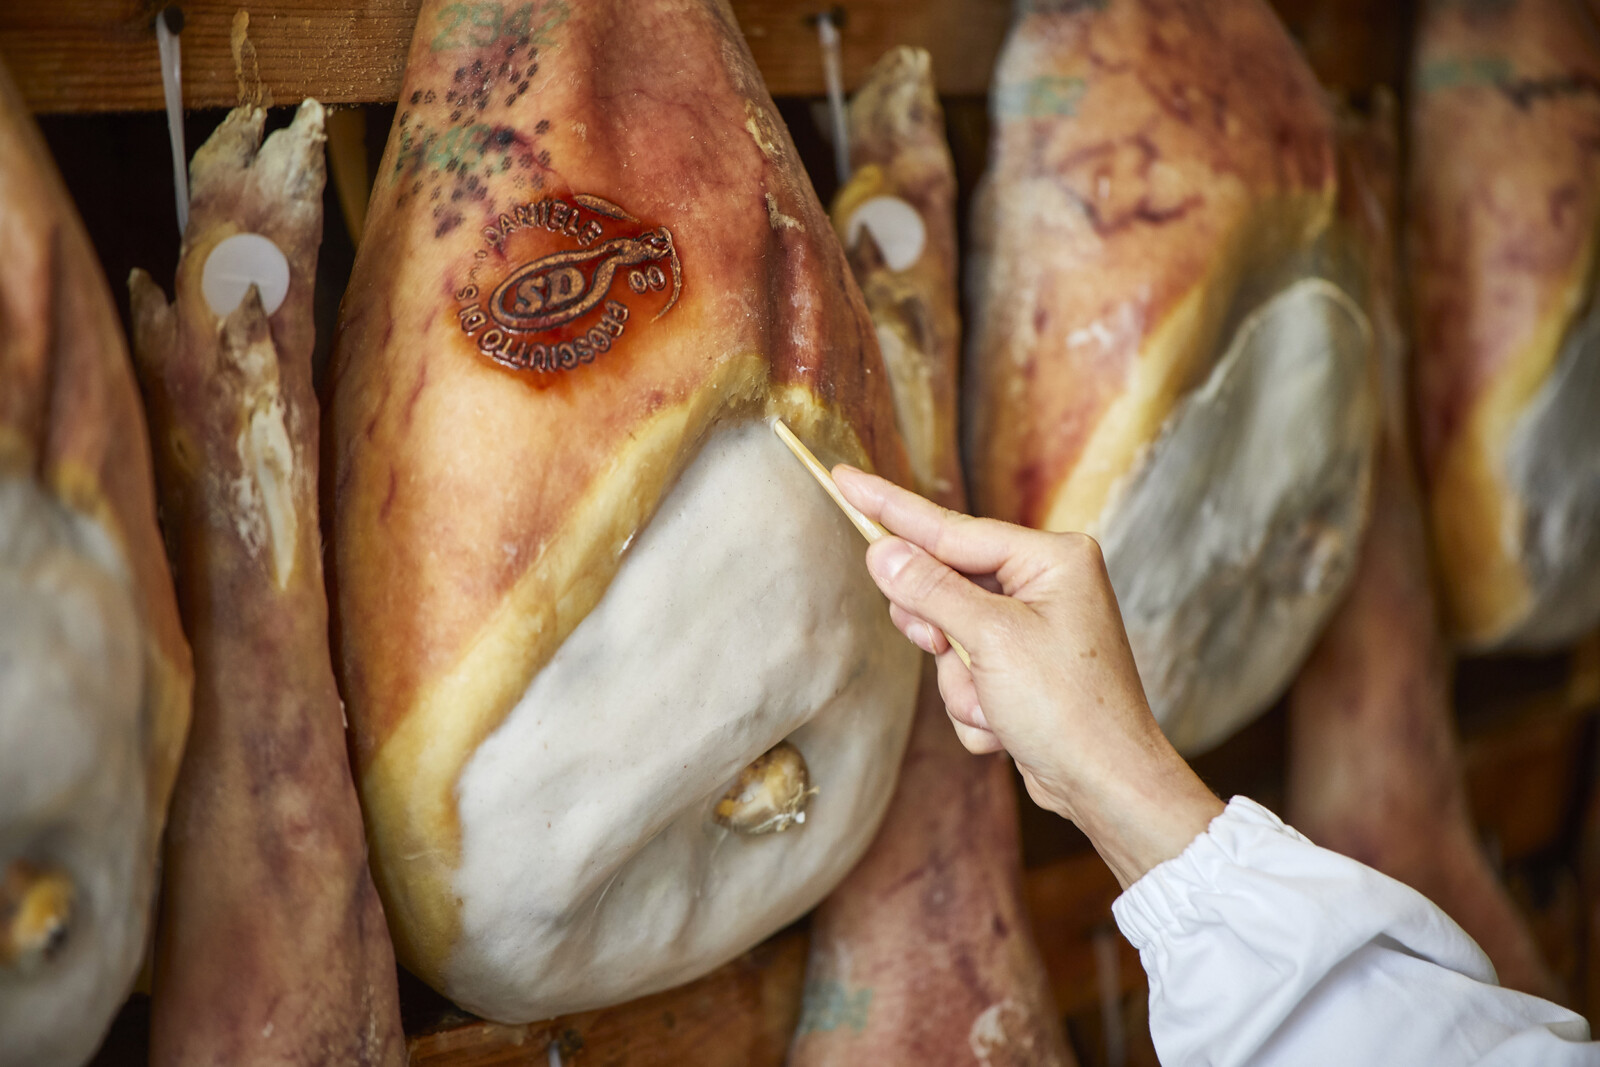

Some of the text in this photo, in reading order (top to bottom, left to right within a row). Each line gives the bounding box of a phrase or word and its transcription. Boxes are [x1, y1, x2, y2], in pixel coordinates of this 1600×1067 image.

[430, 0, 571, 53] 2942
[458, 199, 629, 372] PROSCIUTTO DI DANIELE
[514, 267, 585, 314] SD
